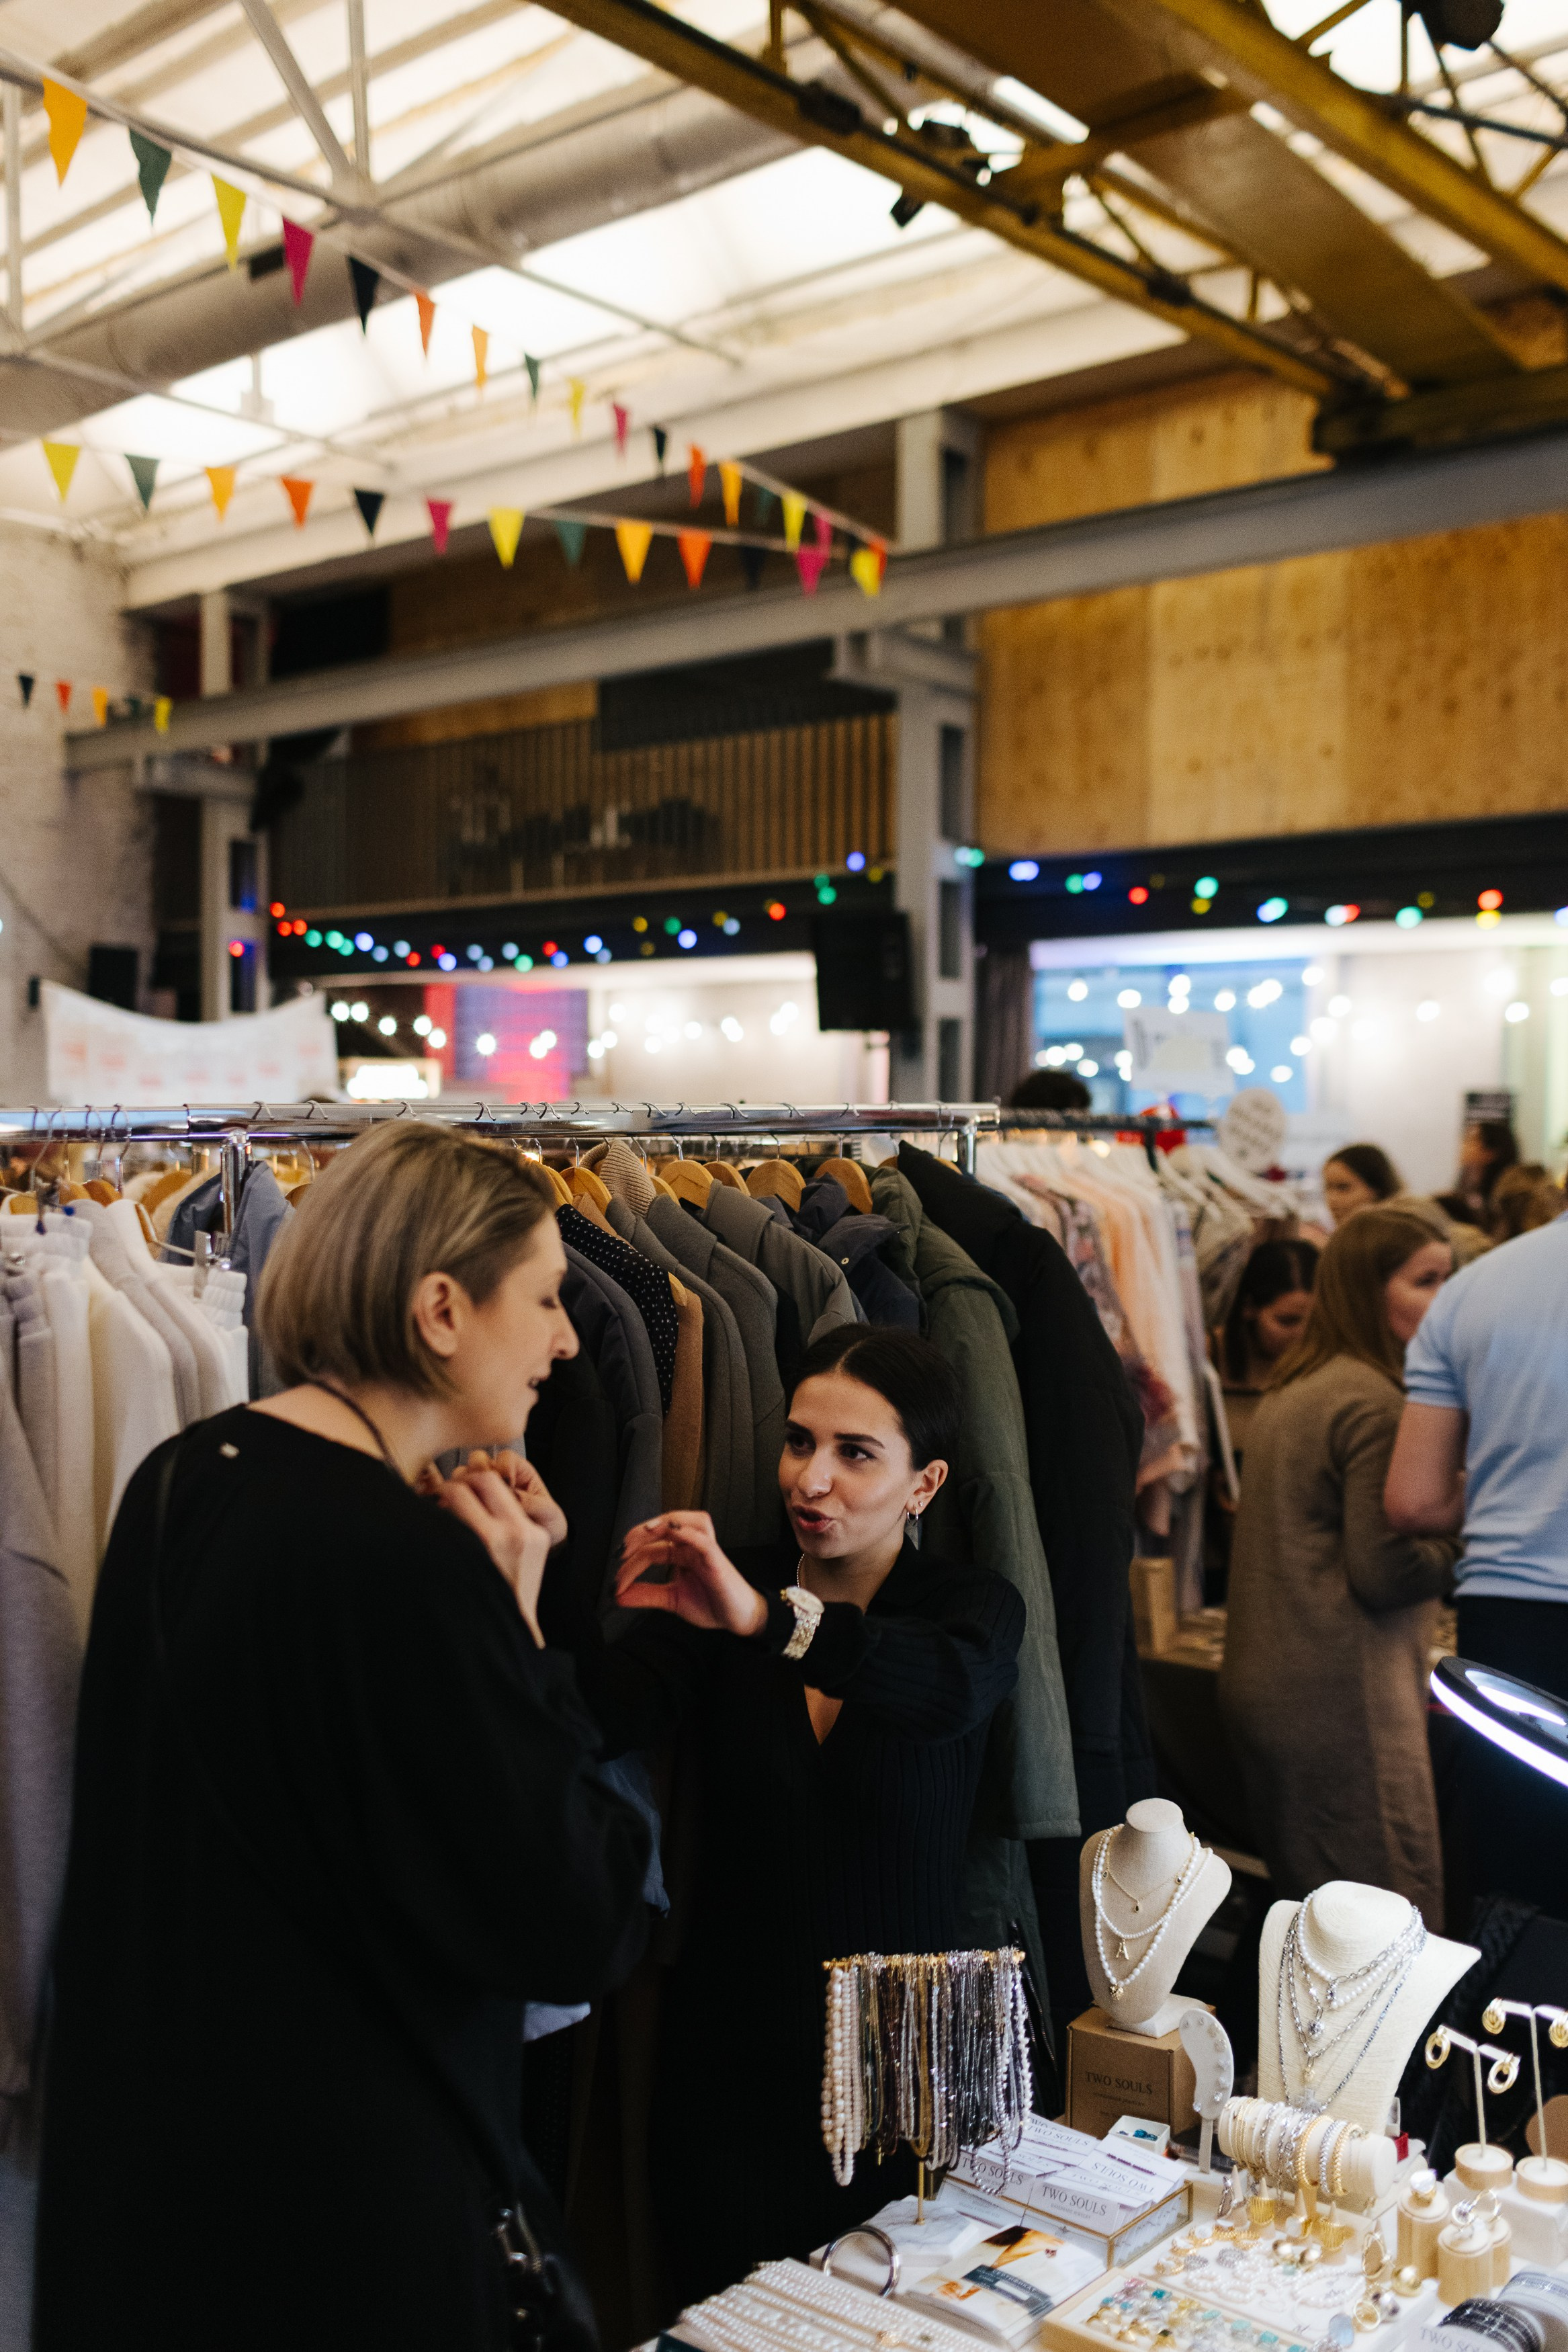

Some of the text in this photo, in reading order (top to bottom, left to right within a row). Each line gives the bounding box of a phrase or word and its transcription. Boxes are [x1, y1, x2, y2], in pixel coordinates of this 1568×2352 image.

[1086, 2072, 1152, 2094] TWO SOULS
[1028, 2126, 1053, 2136] TWO
[1054, 2133, 1089, 2145] SOULS
[1092, 2162, 1129, 2182] SOULS
[1129, 2178, 1155, 2193] TWO
[1042, 2185, 1107, 2216] TWO SOULS
[1420, 2327, 1452, 2349] TWO
